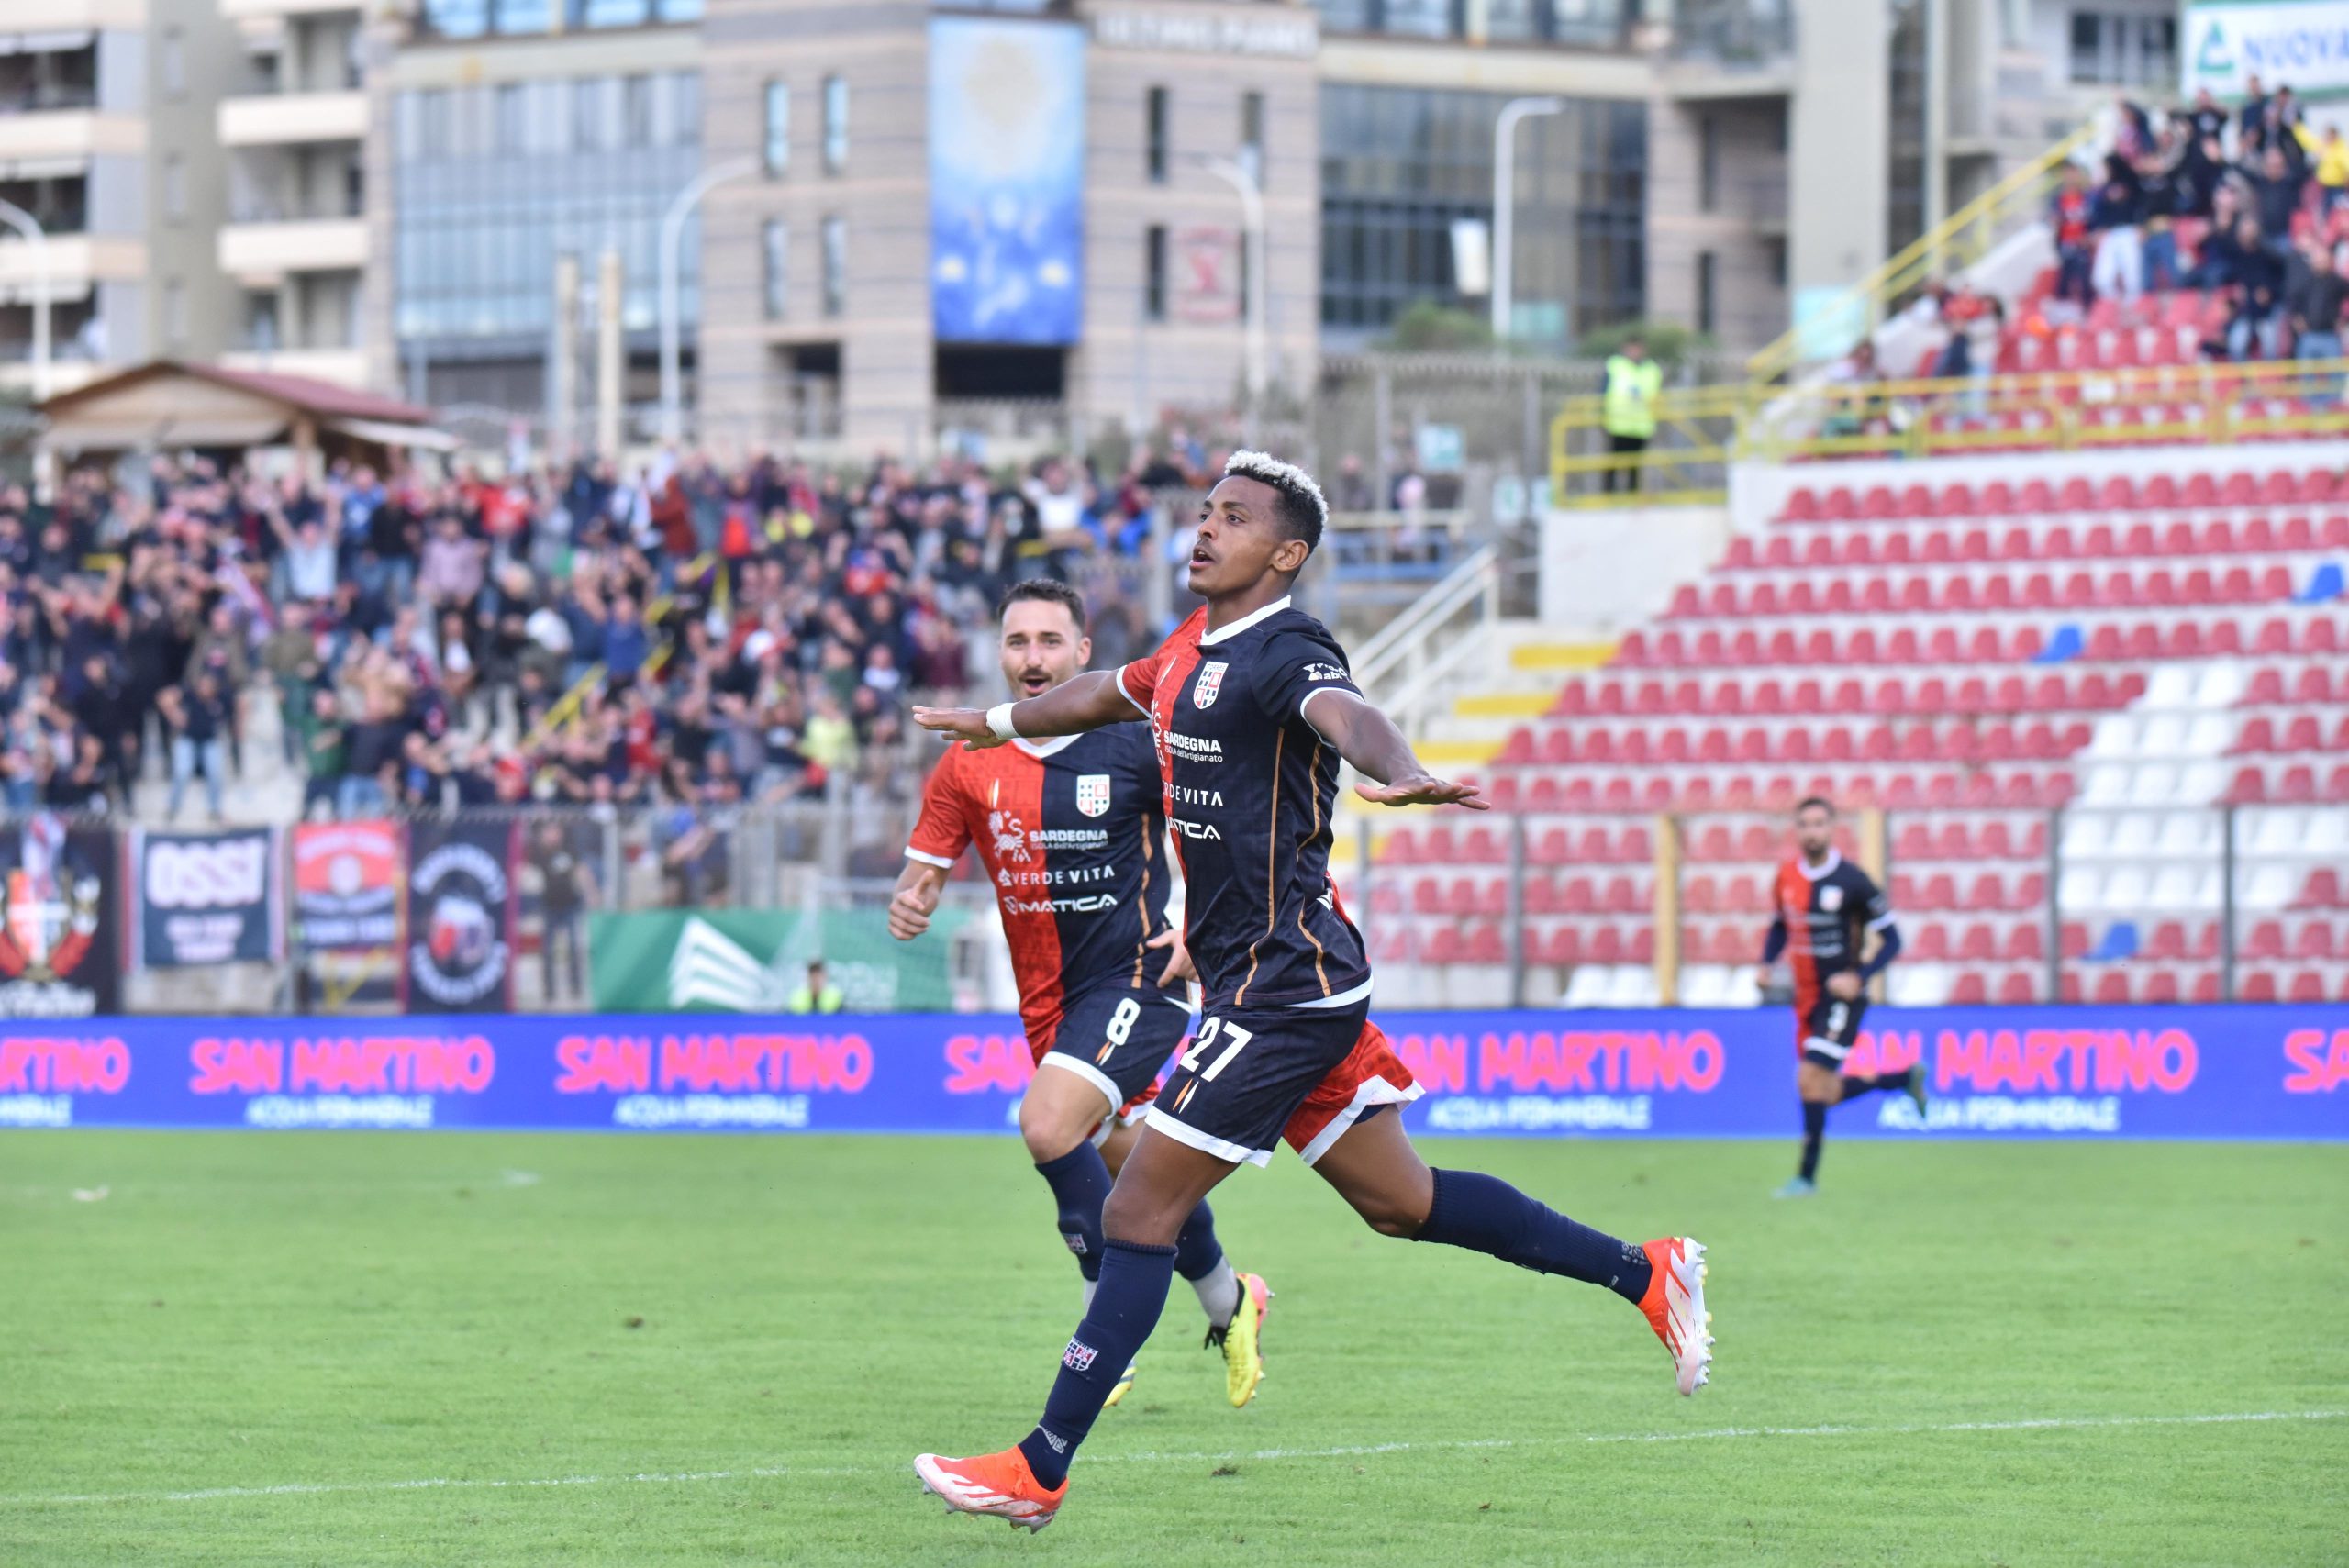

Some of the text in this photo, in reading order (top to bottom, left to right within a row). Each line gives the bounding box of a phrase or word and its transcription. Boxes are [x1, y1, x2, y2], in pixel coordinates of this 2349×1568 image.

[1163, 730, 1222, 753] SARDEGNA
[1184, 787, 1223, 806] VITA
[1029, 829, 1108, 842] SARDEGNA
[1165, 815, 1221, 840] ATICA
[1012, 864, 1115, 885] VERDE VITA
[1019, 893, 1118, 912] MATICA
[1106, 997, 1141, 1046] 8
[189, 1035, 495, 1095] SAN MARTINO
[556, 1034, 873, 1093] SAN MARTINO
[1179, 1016, 1253, 1083] 27
[1390, 1029, 1725, 1093] AN MARTINO
[1842, 1029, 2199, 1093] AN MARTINO
